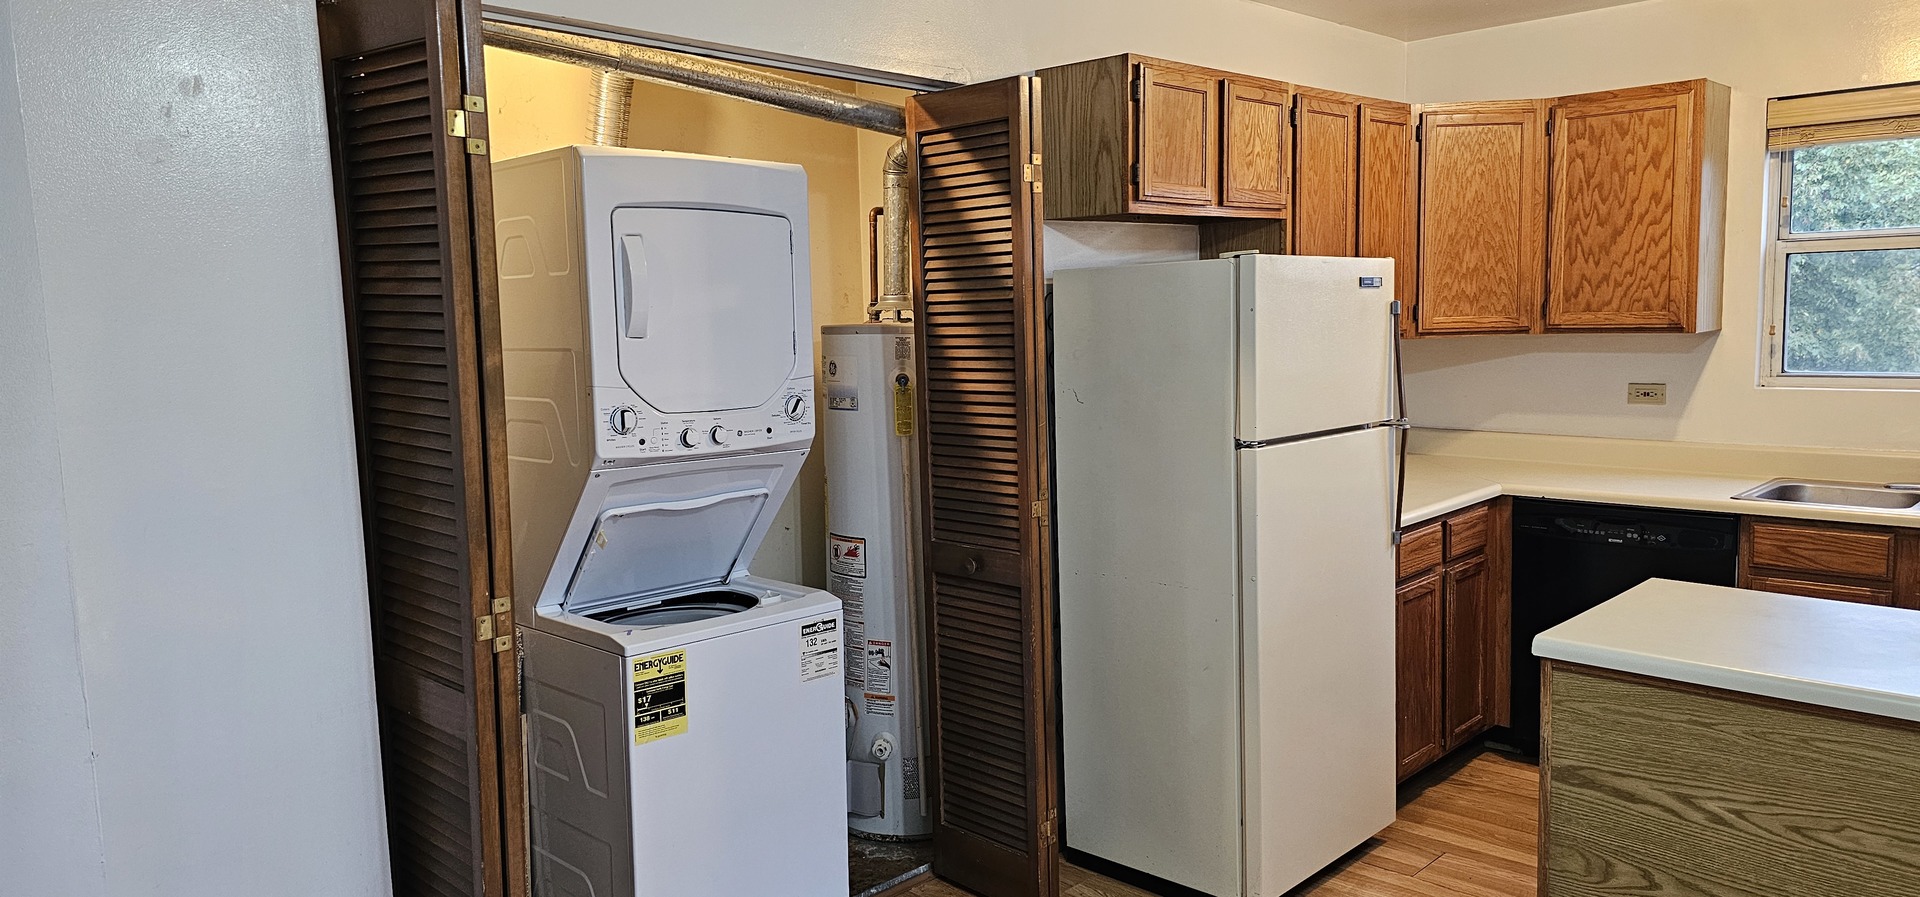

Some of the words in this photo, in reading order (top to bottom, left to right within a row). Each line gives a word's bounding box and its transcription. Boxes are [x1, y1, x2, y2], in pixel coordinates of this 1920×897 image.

[806, 637, 818, 647] 132
[634, 653, 684, 673] ENERGYGUIDE
[637, 695, 652, 704] $17
